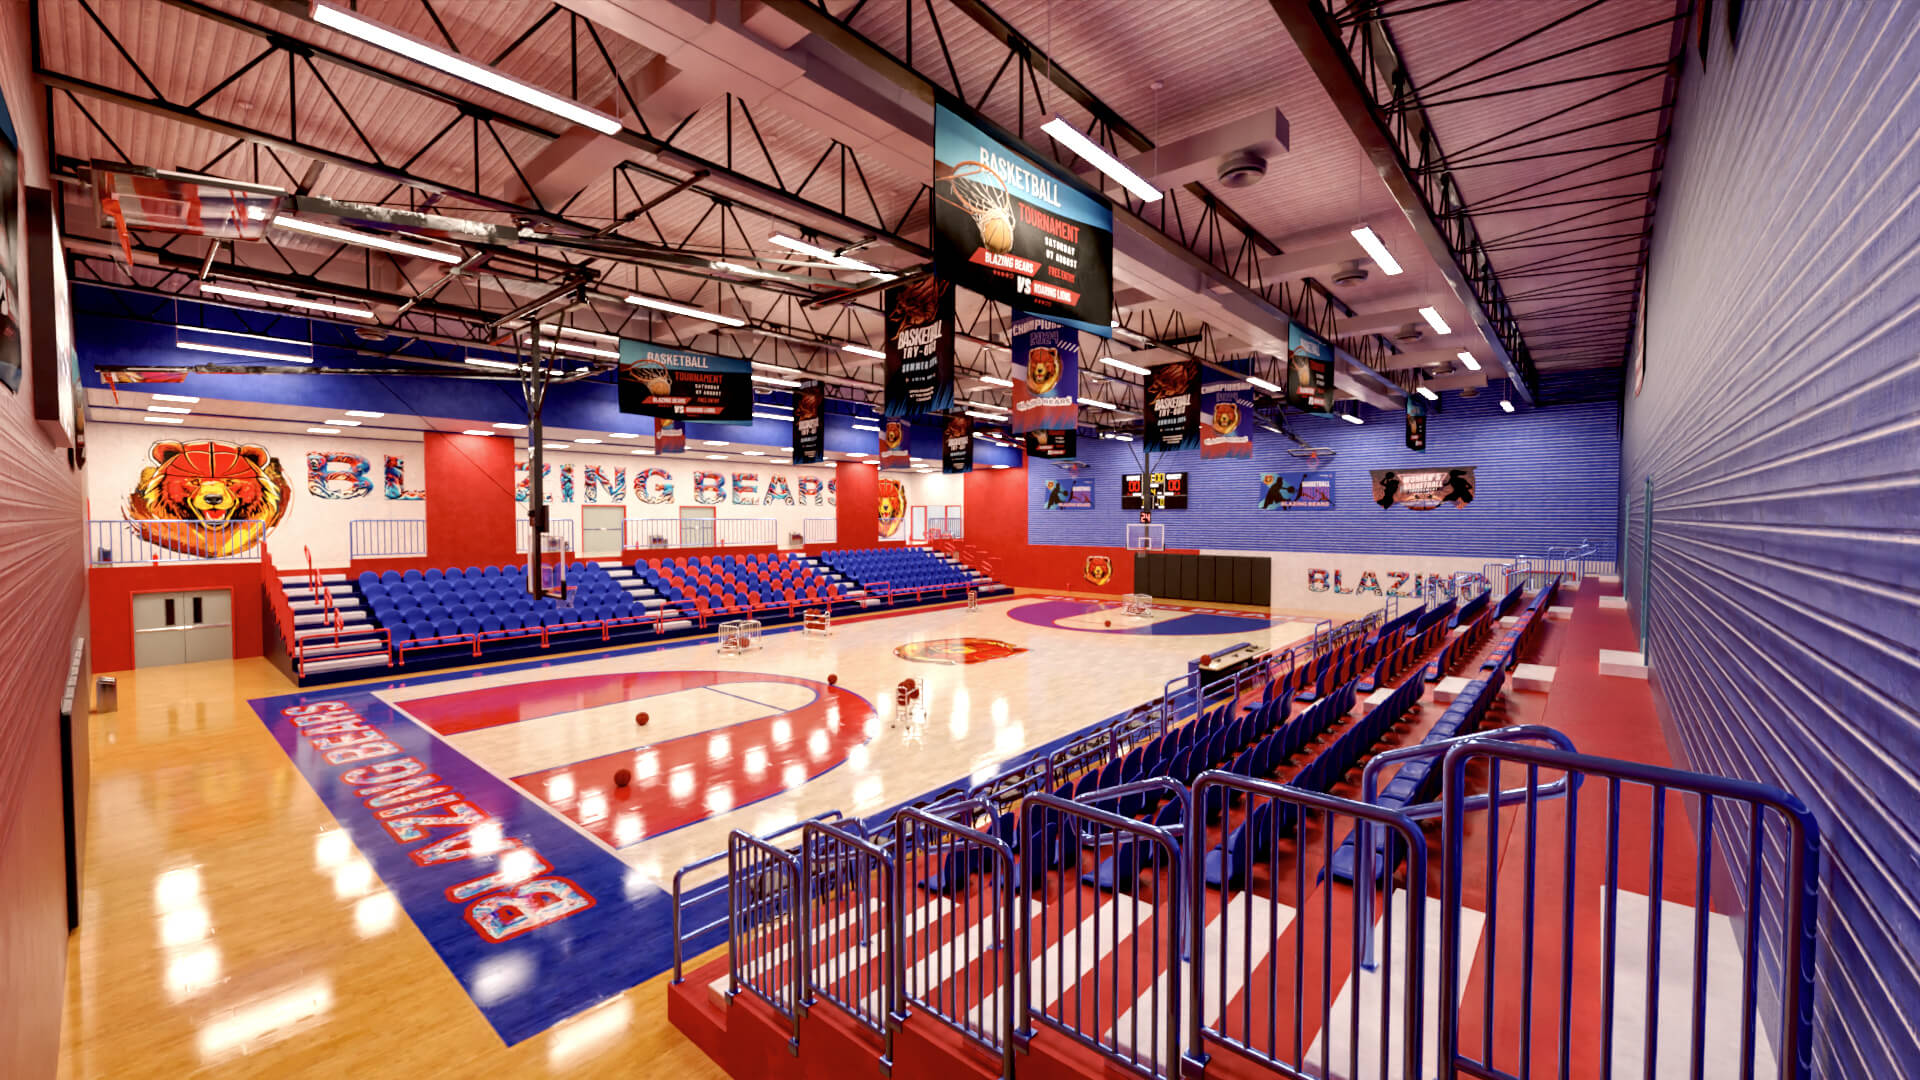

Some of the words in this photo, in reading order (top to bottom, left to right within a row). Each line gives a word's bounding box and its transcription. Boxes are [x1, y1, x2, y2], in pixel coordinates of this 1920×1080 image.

[980, 146, 1062, 208] BASKETBALL
[1018, 201, 1080, 244] TOURNAMENT
[1044, 236, 1075, 256] SATURDAY
[984, 251, 1014, 268] BLAZING
[1014, 258, 1034, 274] BEARS
[1016, 275, 1032, 295] VS
[647, 351, 709, 369] BASKETBALL
[675, 371, 723, 384] TOURNAMENT
[673, 405, 685, 414] VS
[306, 450, 675, 505] BLZING
[1128, 480, 1141, 492] 00
[1167, 479, 1181, 491] 00
[1140, 512, 1151, 523] 24
[281, 699, 405, 766] BEARS
[338, 756, 598, 944] BLAZING
